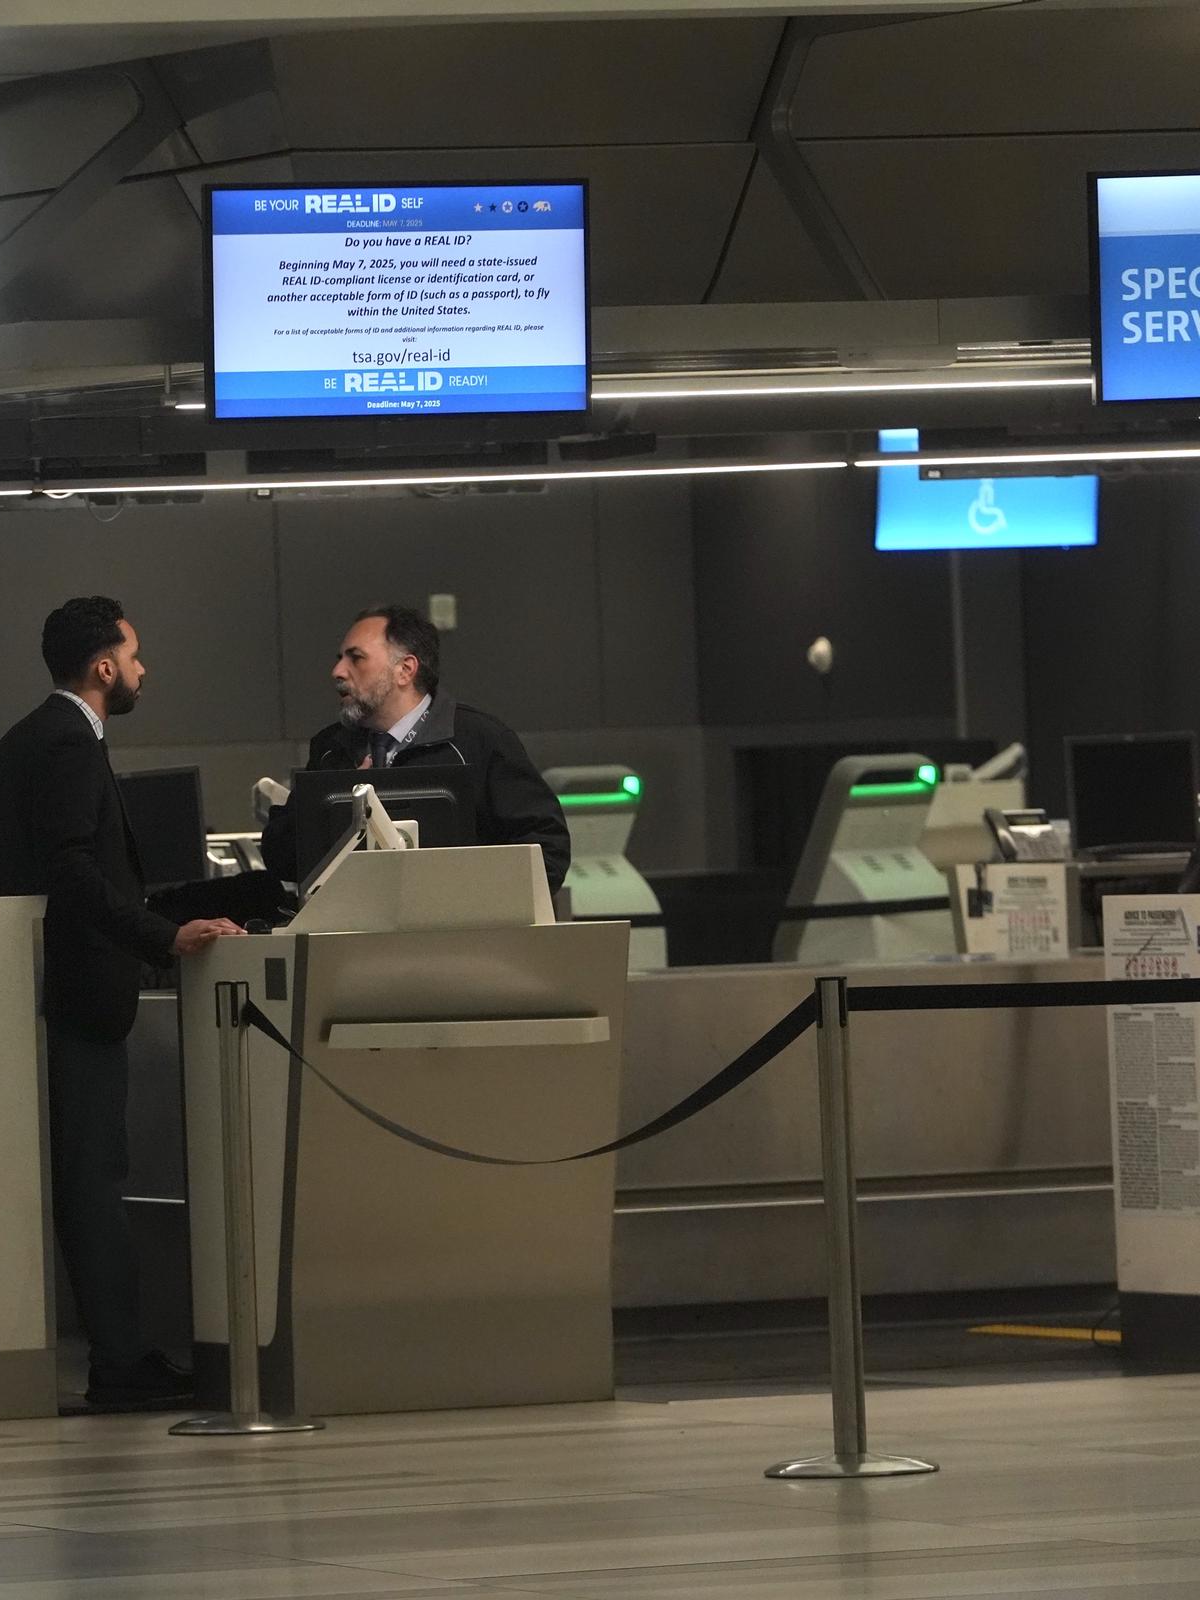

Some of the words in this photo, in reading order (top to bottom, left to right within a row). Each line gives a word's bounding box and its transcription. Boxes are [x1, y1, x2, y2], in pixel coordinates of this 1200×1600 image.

[254, 200, 267, 212] BE
[269, 199, 299, 211] YOUR
[304, 194, 370, 214] REAL
[372, 193, 397, 213] ID
[401, 197, 424, 209] SELF
[346, 220, 382, 228] DEADLINE:
[382, 220, 398, 228] MAY
[406, 219, 424, 227] 2025
[345, 237, 360, 248] Do
[362, 238, 383, 249] you
[385, 236, 412, 247] have
[414, 238, 422, 247] a
[424, 236, 451, 246] REAL
[454, 235, 472, 246] ID?
[279, 260, 330, 272] Beginning
[332, 260, 356, 271] May
[358, 260, 367, 270] 7,
[370, 259, 397, 270] 2025,
[400, 260, 418, 270] you
[421, 258, 439, 268] will
[441, 256, 466, 267] need
[468, 259, 475, 267] a
[477, 256, 538, 267] state-issued
[282, 276, 308, 286] REAL
[310, 275, 375, 287] ID-compliant
[378, 275, 412, 285] license
[414, 275, 426, 284] or
[427, 273, 494, 285] identification
[496, 272, 522, 284] card,
[524, 273, 535, 282] or
[267, 292, 308, 303] another
[310, 290, 364, 303] acceptable
[366, 290, 391, 302] form
[394, 290, 406, 302] of
[406, 290, 418, 300] ID
[420, 289, 447, 301] (such
[449, 291, 460, 300] as
[462, 291, 469, 299] a
[471, 288, 522, 301] passport),
[524, 288, 535, 298] to
[536, 288, 551, 301] fly
[347, 306, 379, 317] within
[382, 306, 398, 316] the
[401, 305, 435, 316] United
[437, 305, 471, 316] States.
[274, 328, 284, 336] For
[291, 328, 301, 336] list
[302, 328, 309, 337] of
[310, 327, 344, 337] acceptable
[344, 327, 364, 336] forms
[364, 327, 372, 336] of
[394, 326, 426, 334] additional
[427, 325, 464, 334] information
[465, 325, 496, 334] regarding
[524, 324, 545, 332] please
[352, 348, 451, 366] tsa.gov/real-id
[324, 378, 337, 390] BE
[344, 372, 415, 393] REAL
[417, 371, 444, 392] ID
[448, 374, 488, 387] READY!
[367, 400, 400, 409] Deadline:
[400, 400, 415, 409] May
[416, 400, 423, 408] 7,
[424, 400, 441, 408] 2025
